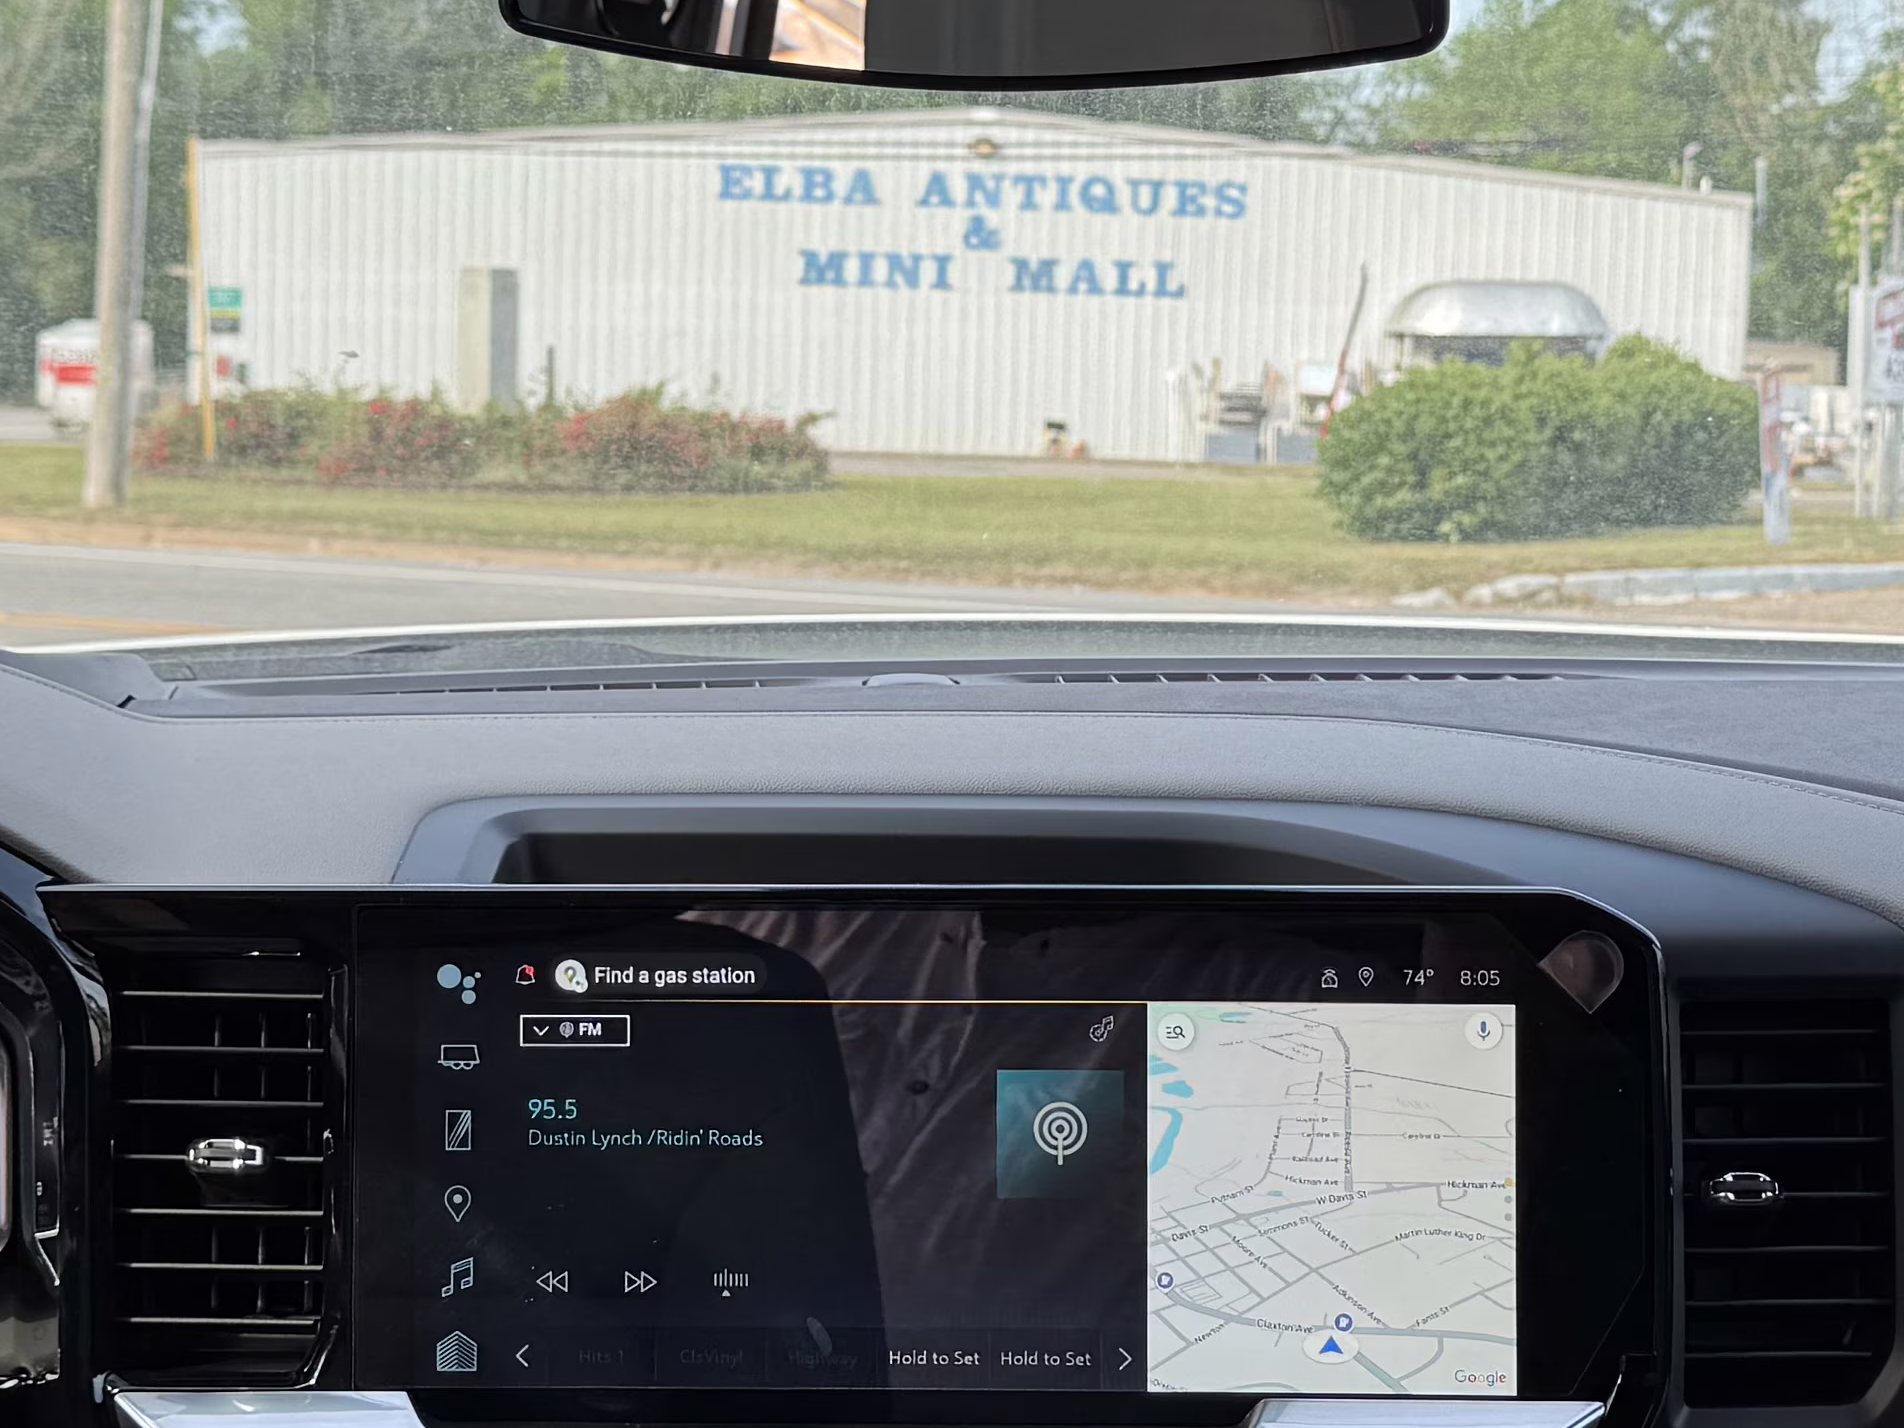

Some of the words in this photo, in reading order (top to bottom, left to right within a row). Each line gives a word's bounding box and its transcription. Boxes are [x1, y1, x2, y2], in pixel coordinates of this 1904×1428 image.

[718, 163, 882, 205] ELBA
[917, 170, 1249, 219] ANTIQUES
[962, 215, 1002, 252] &
[797, 249, 954, 291] MINI
[1009, 257, 1186, 299] MALL
[595, 966, 633, 984] Find
[639, 970, 649, 984] a
[654, 970, 687, 988] gas
[692, 967, 756, 984] station
[1460, 970, 1501, 987] 8:05
[579, 1022, 602, 1036] FM
[528, 1098, 577, 1120] 95.5
[528, 1129, 585, 1146] Dustin
[592, 1129, 642, 1151] Lynch
[708, 1130, 764, 1147] Roads
[1447, 1180, 1486, 1190] Hickman
[1325, 1192, 1355, 1205] Davis
[1313, 1219, 1341, 1244] Tucker
[1395, 1228, 1423, 1242] Martin
[1424, 1227, 1452, 1239] Luther
[1454, 1230, 1474, 1241] King
[1194, 1321, 1226, 1345] Newton
[888, 1349, 927, 1366] Hold
[932, 1351, 949, 1366] to
[954, 1349, 981, 1366] Set
[1000, 1350, 1039, 1367] Hold
[1044, 1352, 1060, 1367] to
[1065, 1350, 1092, 1367] Set
[1454, 1369, 1507, 1387] Google
